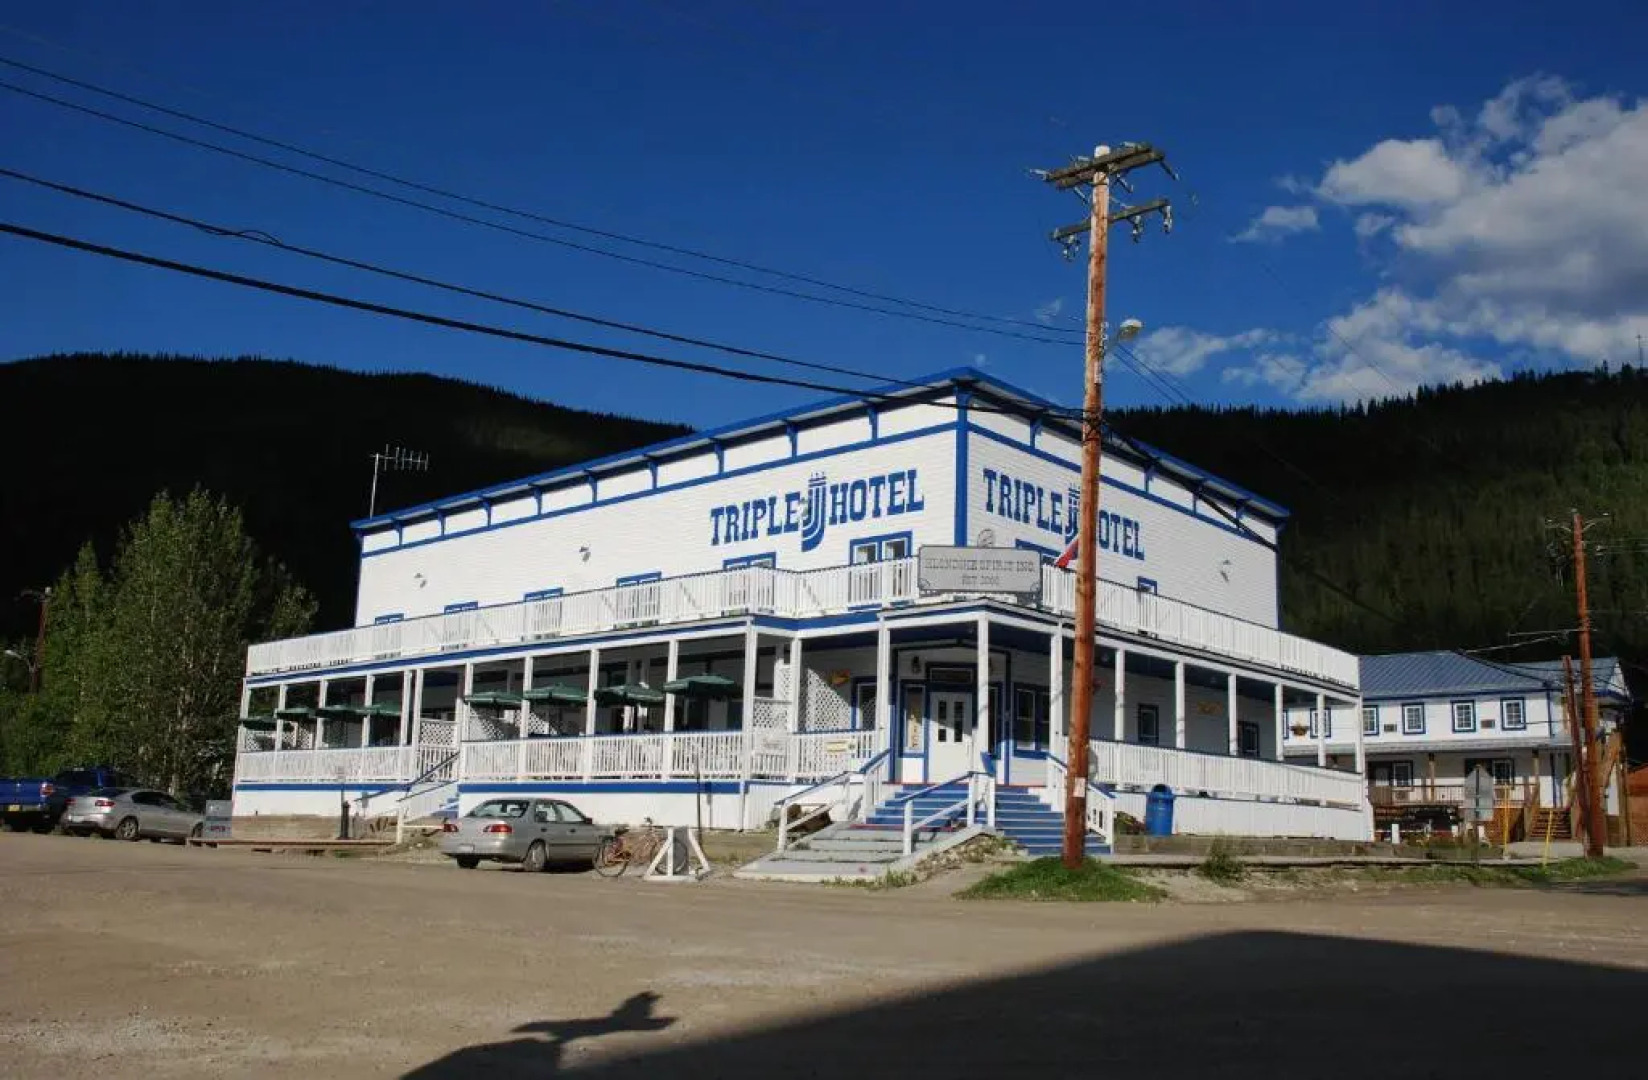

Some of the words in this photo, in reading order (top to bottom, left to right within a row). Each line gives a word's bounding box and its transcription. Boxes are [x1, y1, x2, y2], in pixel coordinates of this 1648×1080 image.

[710, 491, 801, 546] TRIPLE
[829, 469, 925, 525] HOTEL
[983, 468, 1063, 535] TRIPLE
[1098, 509, 1145, 561] OTEL
